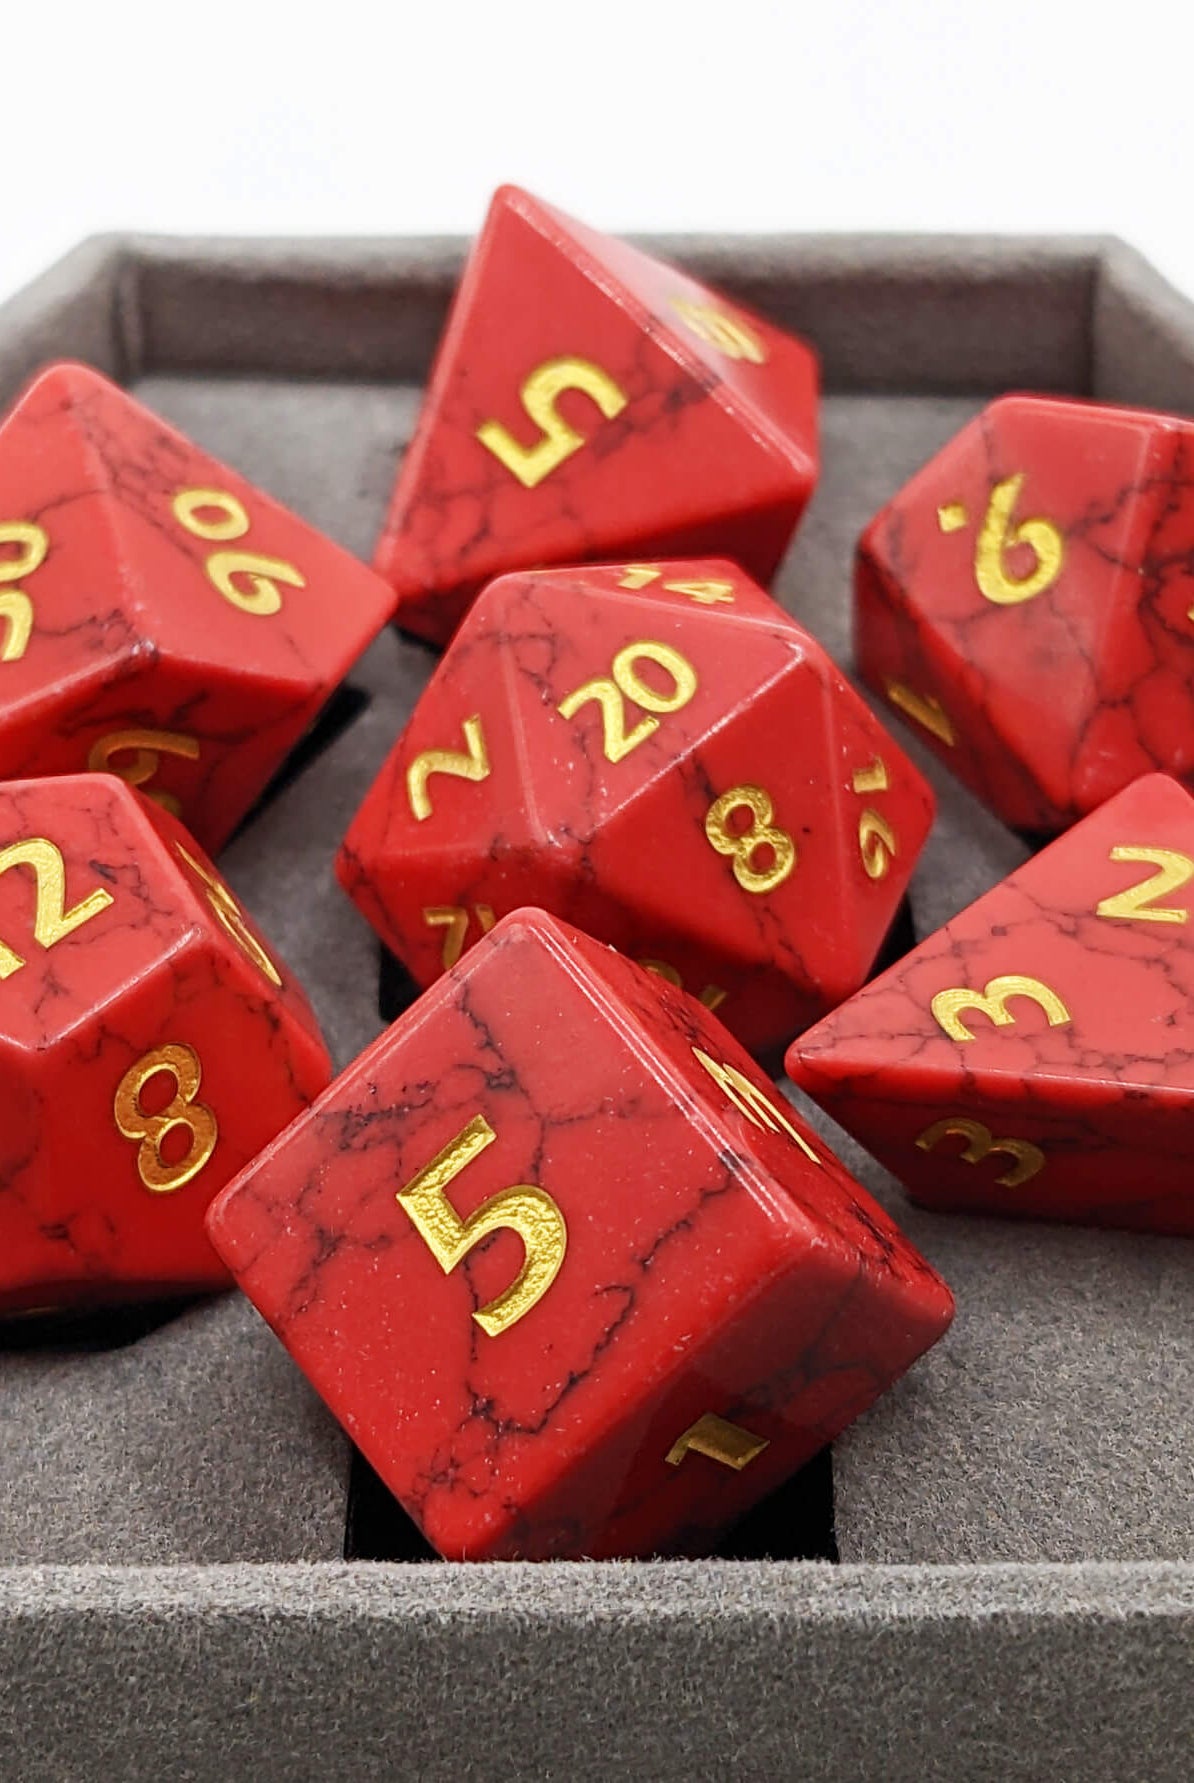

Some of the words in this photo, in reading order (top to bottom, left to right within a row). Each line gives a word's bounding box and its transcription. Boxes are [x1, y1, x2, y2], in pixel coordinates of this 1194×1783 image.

[476, 356, 628, 489] 5
[557, 639, 698, 764] 20
[406, 713, 491, 821] 2
[705, 785, 796, 894] 8
[1096, 846, 1194, 924] 2
[931, 974, 1071, 1042] 3
[114, 1043, 218, 1192] 8
[915, 1117, 1046, 1188] 3
[396, 1114, 568, 1338] 5
[664, 1413, 771, 1472] 1
